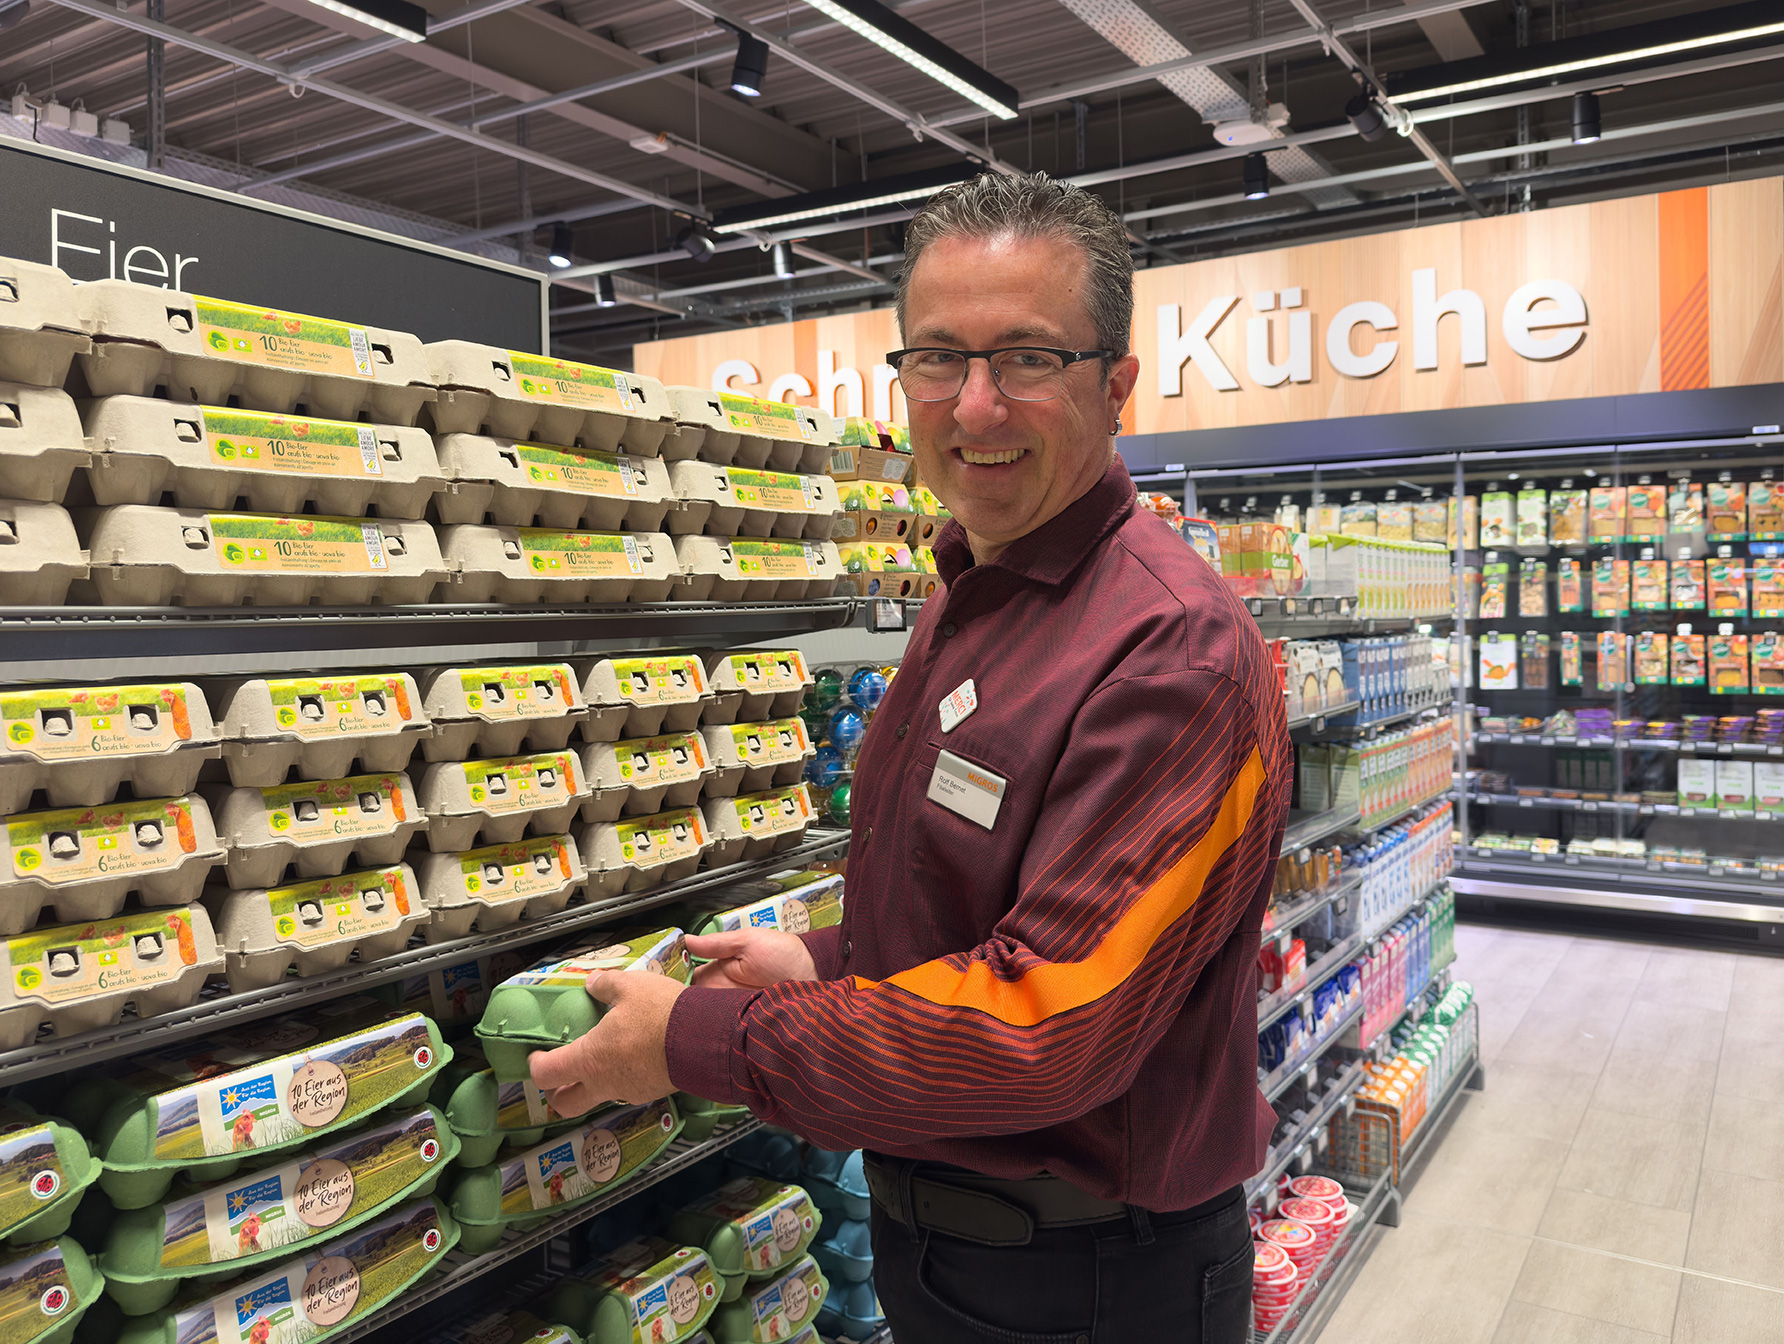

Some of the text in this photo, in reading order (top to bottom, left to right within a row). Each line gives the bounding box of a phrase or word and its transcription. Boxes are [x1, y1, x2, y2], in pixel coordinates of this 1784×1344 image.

[51, 208, 199, 293] Eier
[1157, 267, 1588, 397] Küche
[260, 335, 277, 351] 10
[555, 381, 568, 393] 10
[267, 440, 285, 456] 10
[560, 467, 573, 479] 10
[274, 541, 291, 556] 10
[564, 552, 577, 565] 10
[659, 690, 664, 700] 6
[951, 690, 966, 715] MERCI
[517, 703, 523, 715] 6
[339, 717, 347, 731] 6
[91, 735, 101, 751] 6
[659, 769, 665, 780] 6
[939, 775, 948, 785] Rolf
[519, 794, 525, 806] 6
[334, 820, 342, 834] 6
[660, 849, 665, 859] 6
[98, 855, 108, 872] 6
[514, 880, 521, 893] 6
[338, 920, 346, 935] 6
[98, 971, 108, 988] 6
[291, 1074, 341, 1099] 10 Eier aus
[292, 1086, 345, 1114] der Region
[298, 1171, 348, 1200] 10 Eier aus
[299, 1184, 351, 1214] der Region
[305, 1268, 354, 1299] 10 Eier aus
[307, 1280, 358, 1314] der Region
